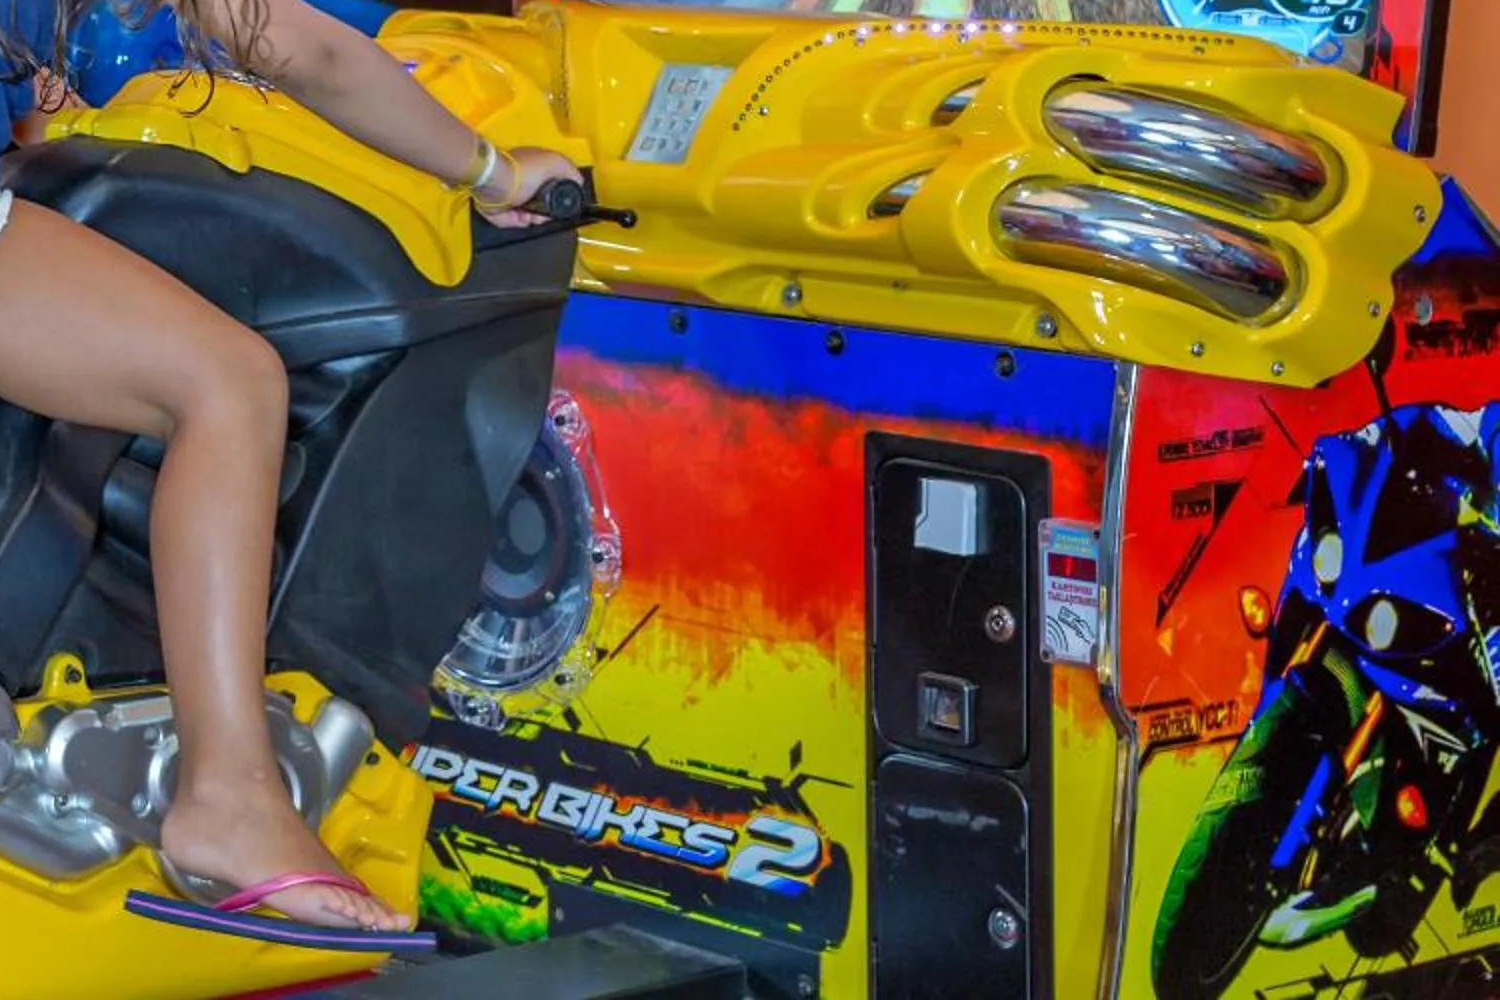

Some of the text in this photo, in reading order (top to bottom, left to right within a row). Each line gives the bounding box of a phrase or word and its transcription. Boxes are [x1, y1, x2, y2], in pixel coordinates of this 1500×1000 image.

[1343, 15, 1358, 31] 4
[536, 781, 738, 869] BIKES
[726, 815, 824, 896] 2
